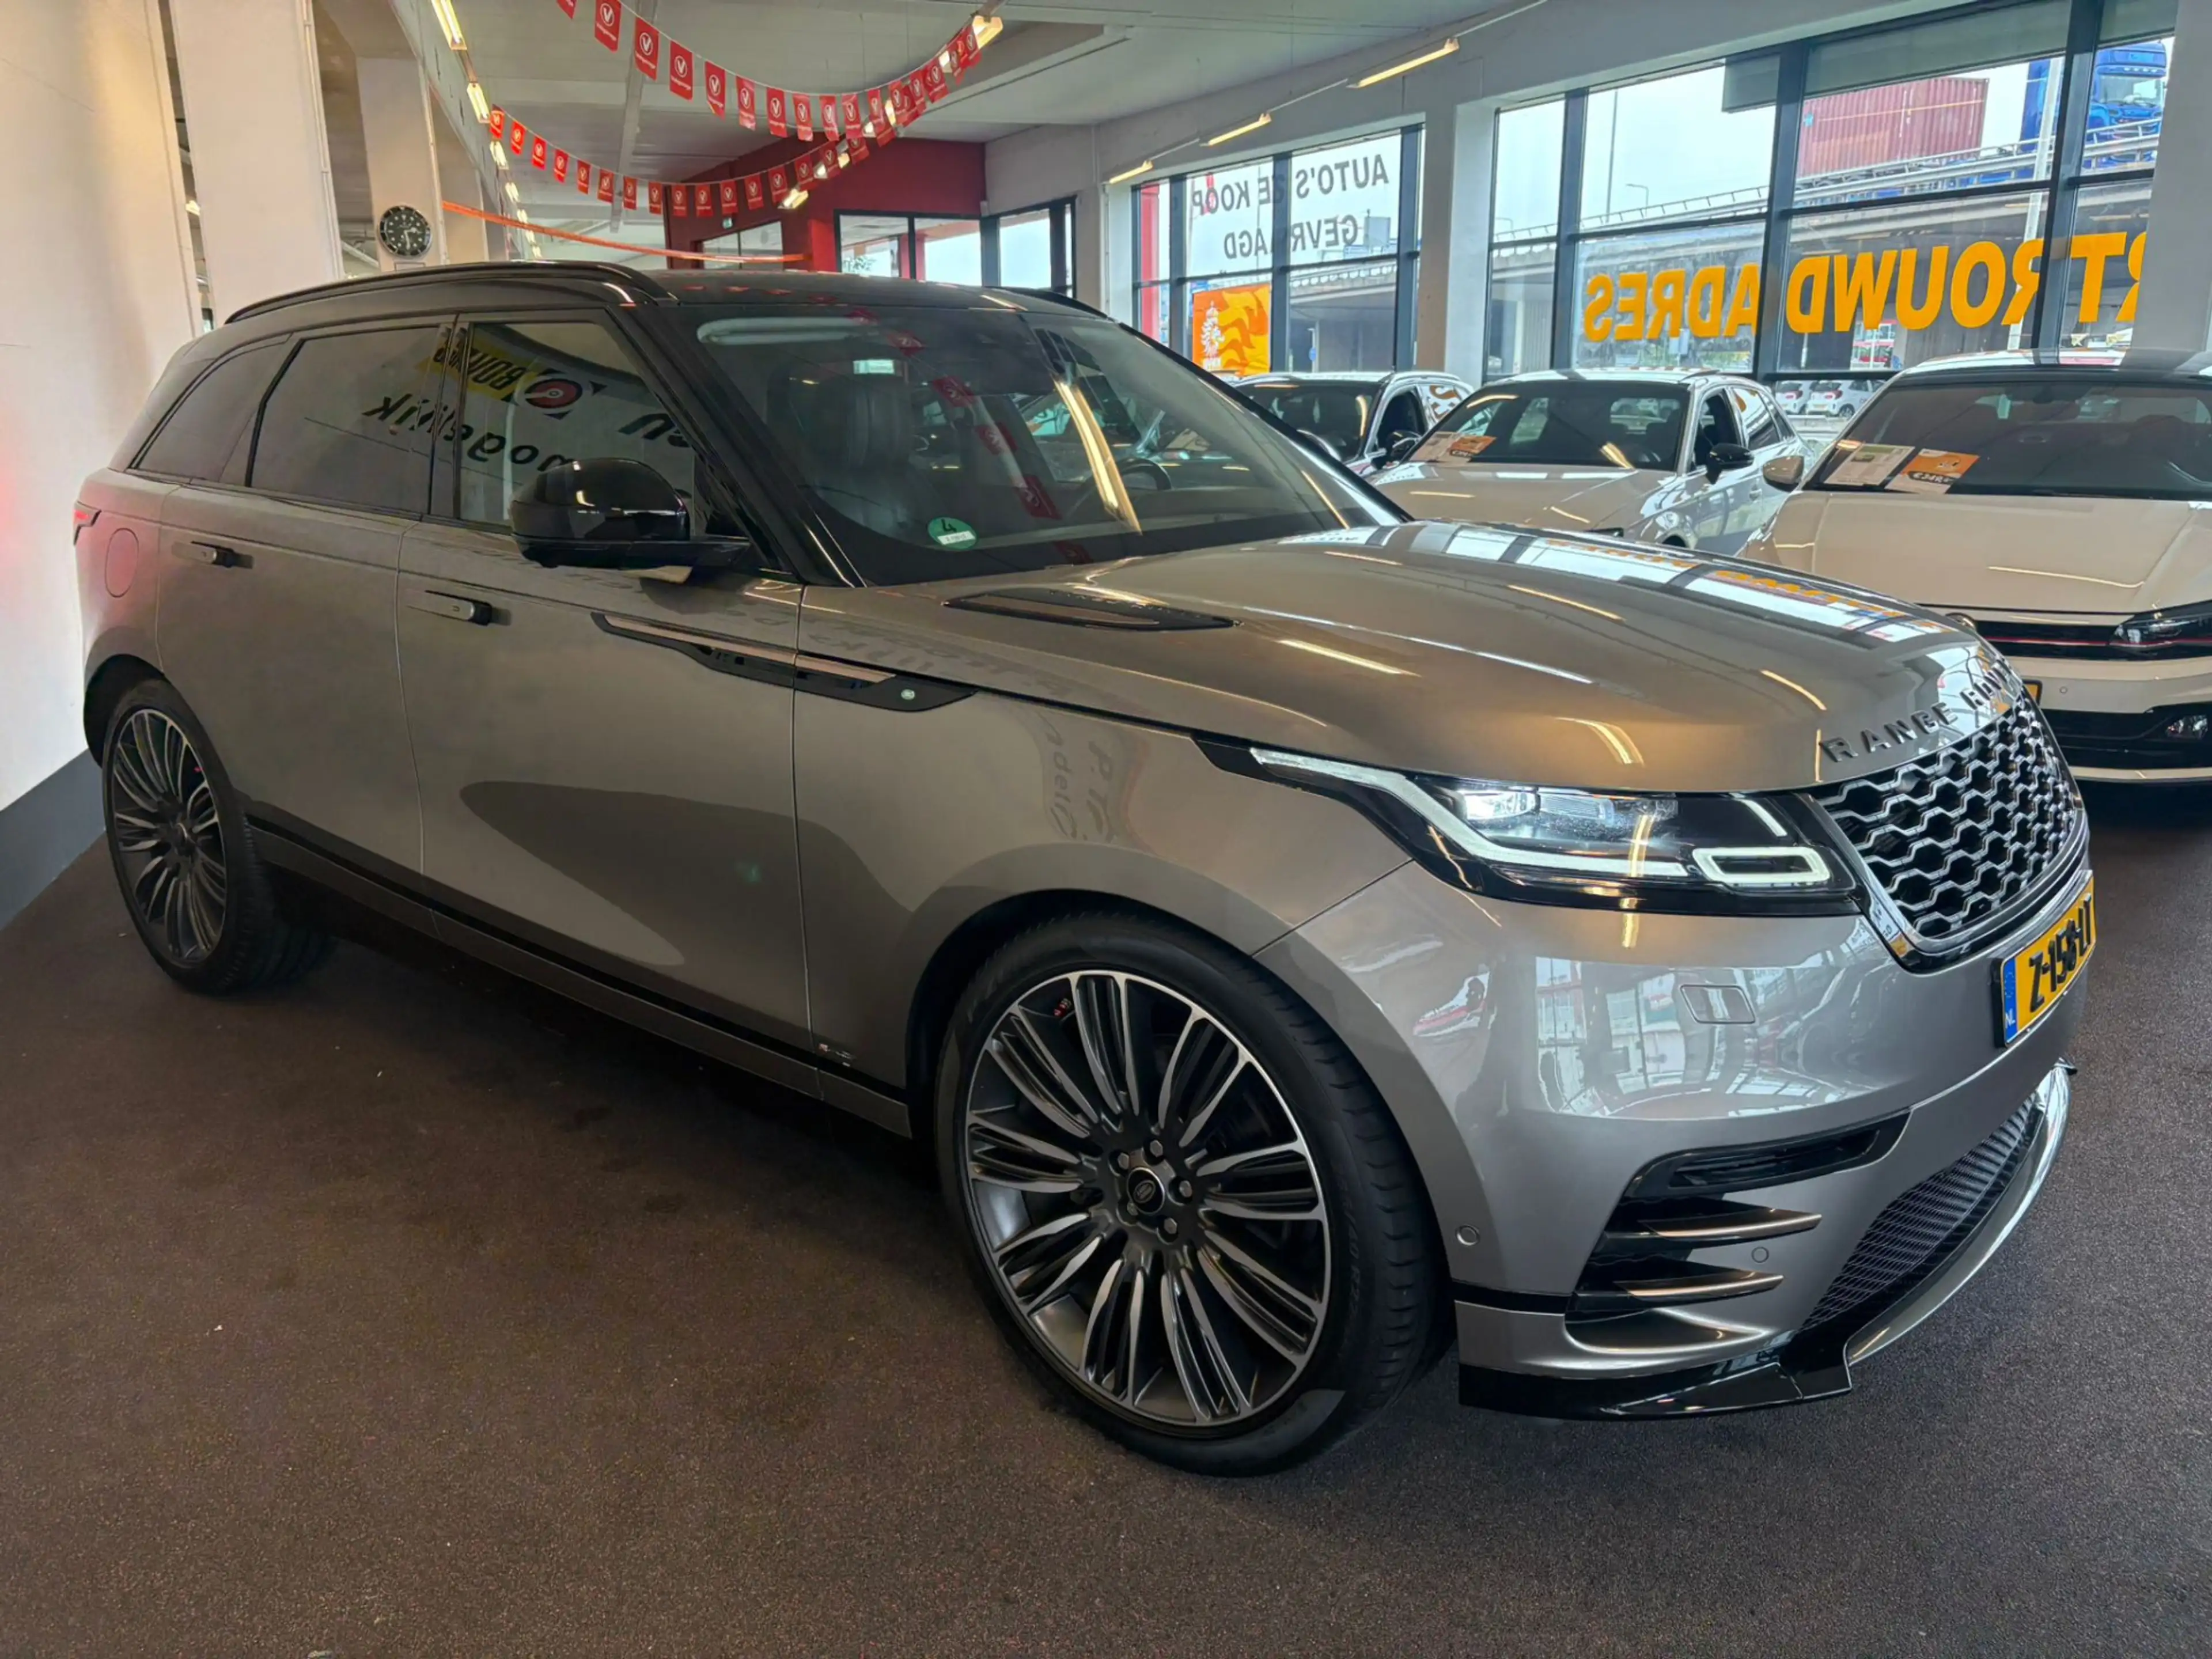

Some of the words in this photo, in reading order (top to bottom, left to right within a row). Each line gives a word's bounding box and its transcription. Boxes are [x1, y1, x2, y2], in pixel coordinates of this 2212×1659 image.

[941, 518, 957, 532] 4
[1821, 701, 1959, 762] RANGE
[2005, 1012, 2016, 1029] NL
